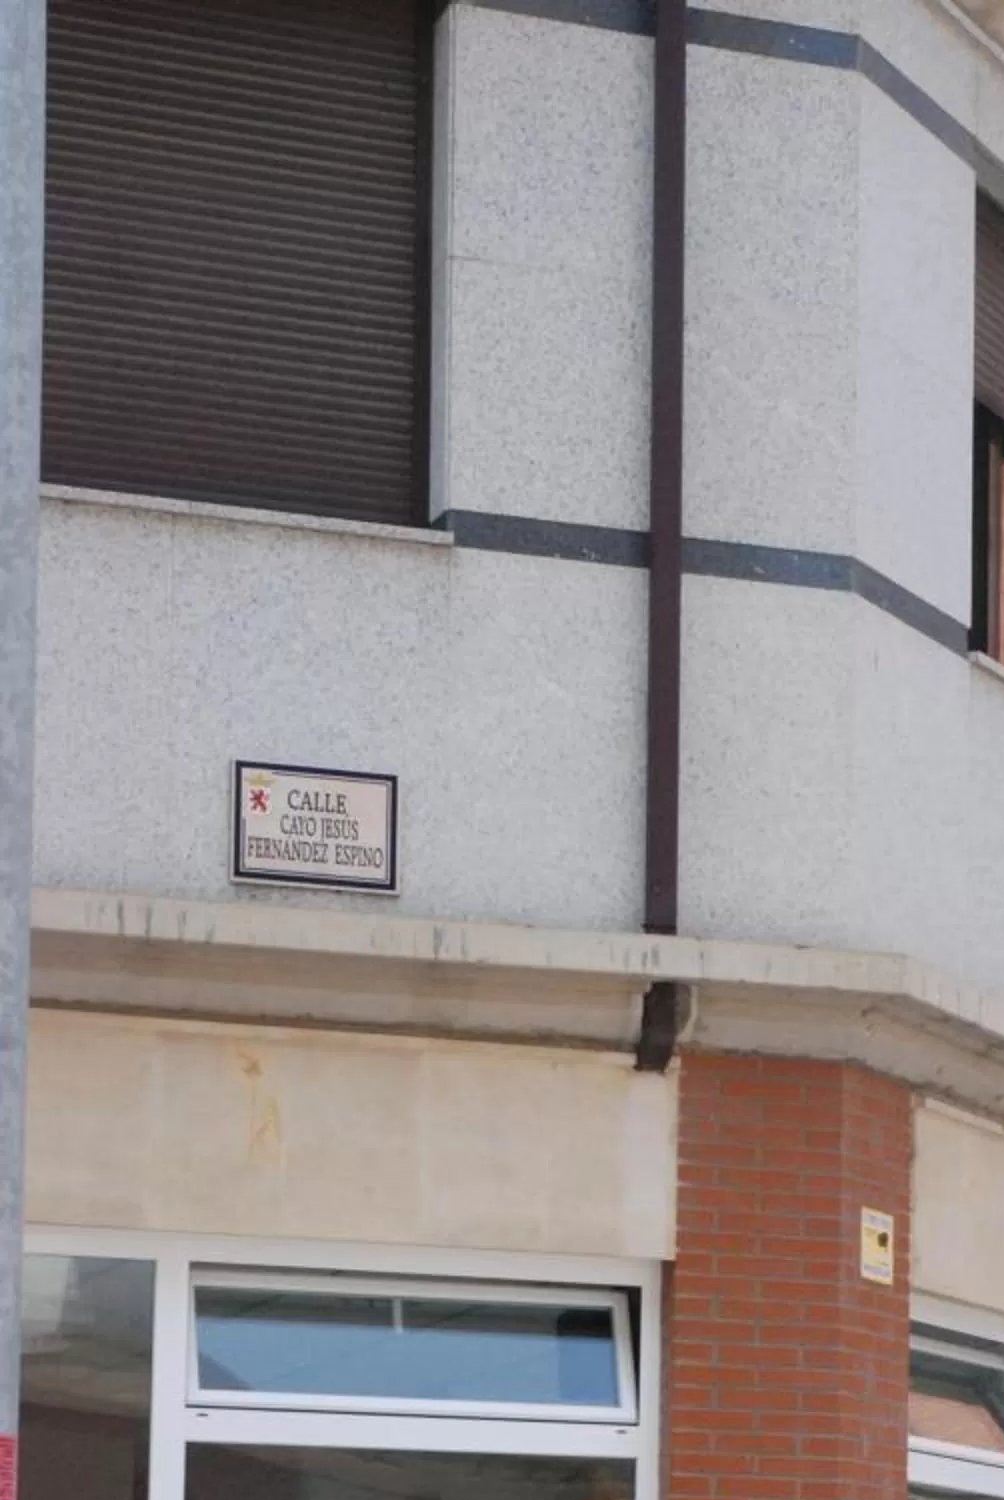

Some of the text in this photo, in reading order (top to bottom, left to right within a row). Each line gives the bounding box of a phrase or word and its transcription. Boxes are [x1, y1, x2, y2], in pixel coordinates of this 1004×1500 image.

[287, 789, 347, 815] CALLE
[280, 814, 317, 836] CAYO
[335, 843, 384, 868] ESPINO
